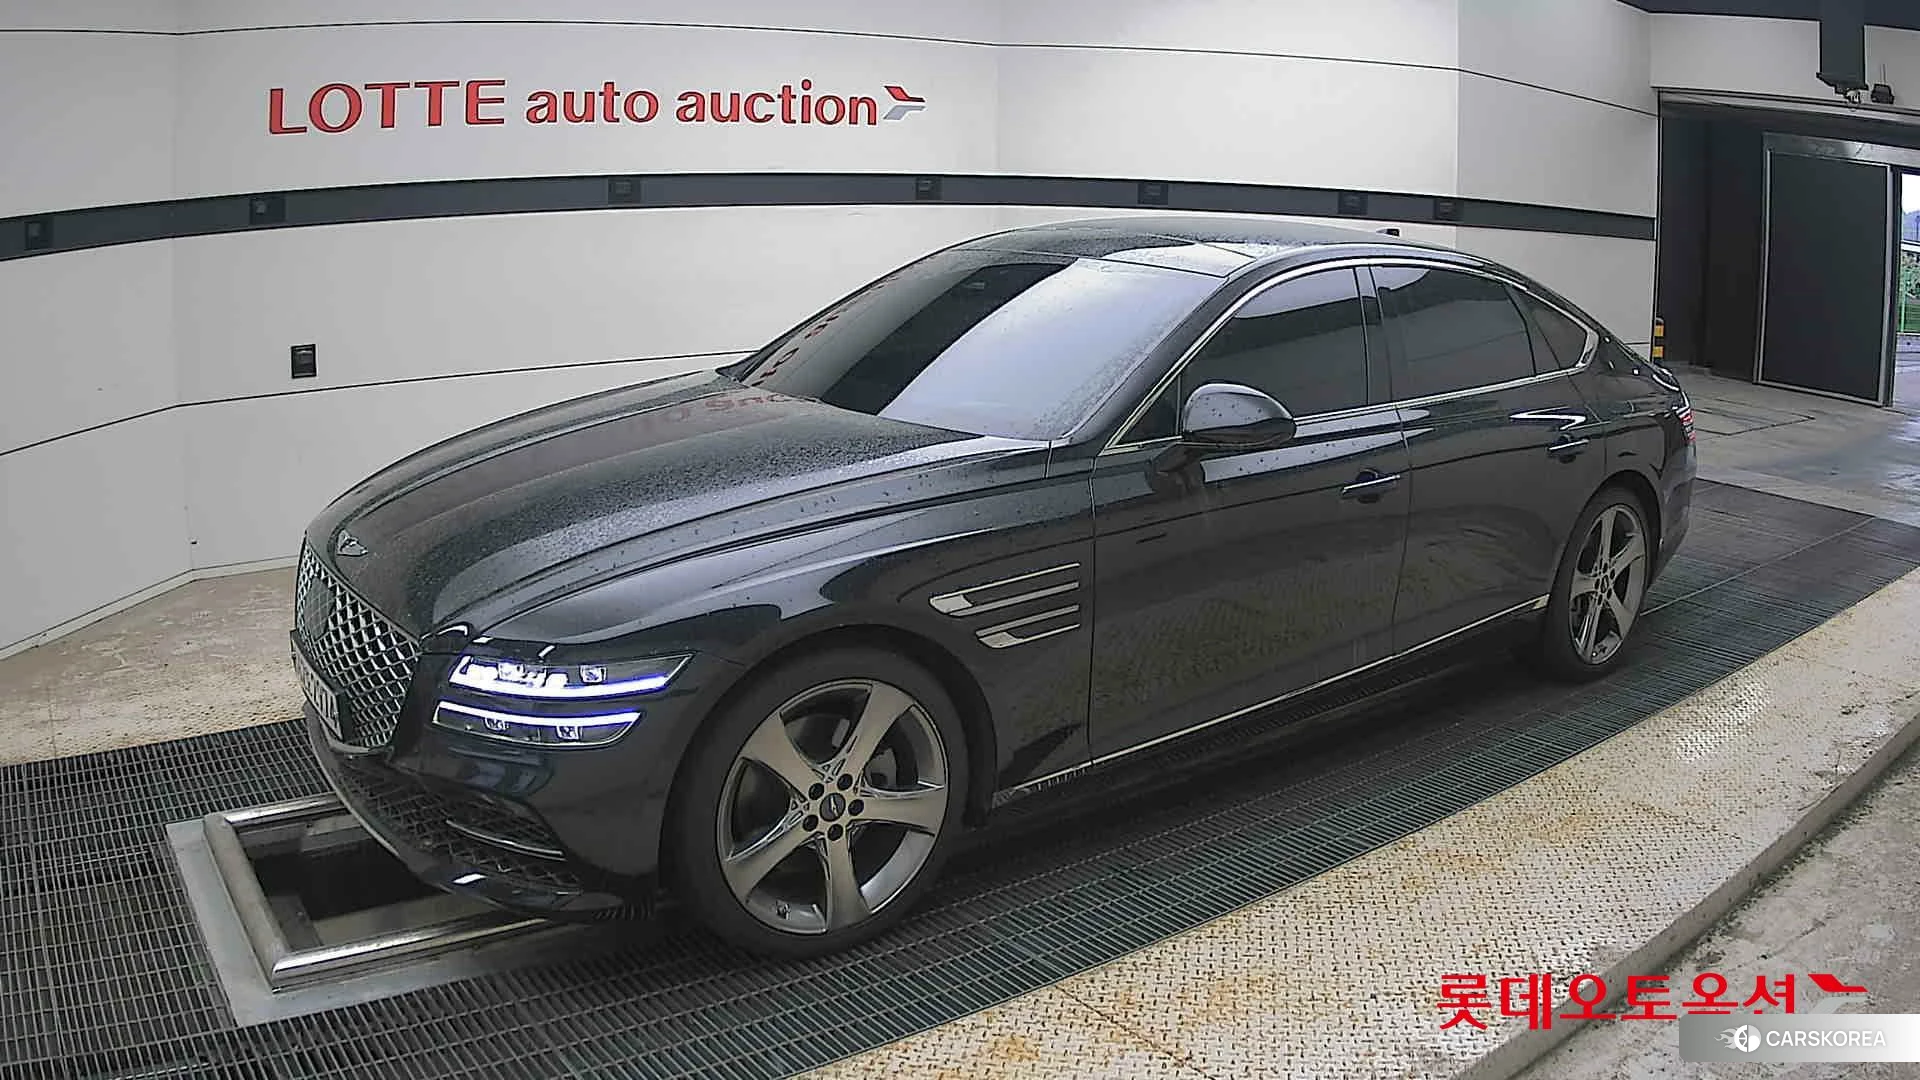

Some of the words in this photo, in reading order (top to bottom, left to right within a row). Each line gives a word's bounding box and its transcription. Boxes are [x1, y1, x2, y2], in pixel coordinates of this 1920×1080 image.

[269, 80, 505, 135] LOTTE
[526, 82, 659, 124] auto
[675, 80, 878, 126] auction
